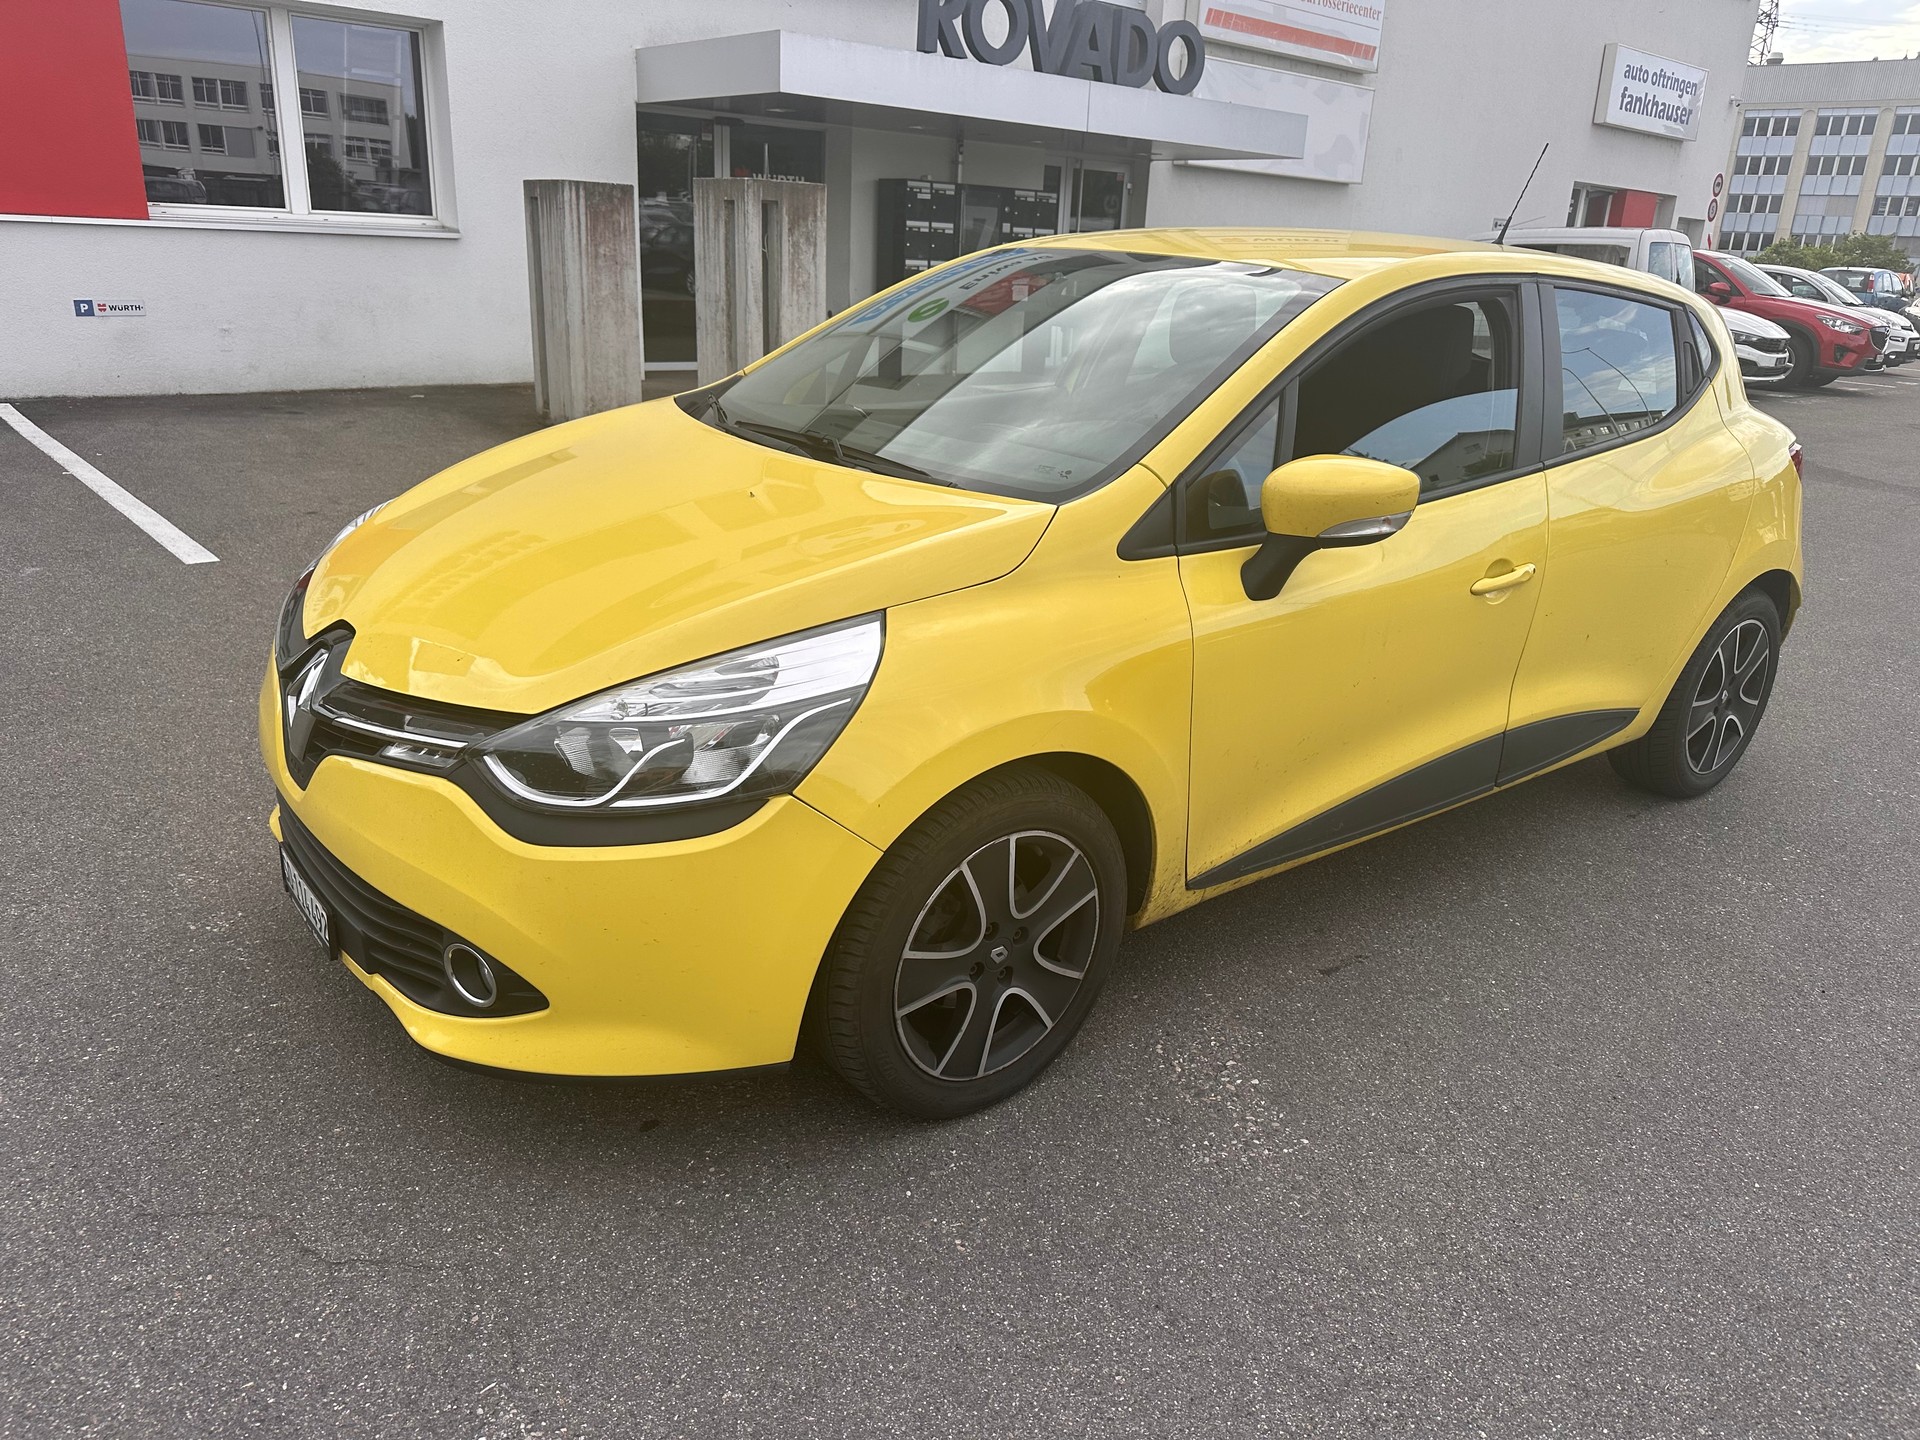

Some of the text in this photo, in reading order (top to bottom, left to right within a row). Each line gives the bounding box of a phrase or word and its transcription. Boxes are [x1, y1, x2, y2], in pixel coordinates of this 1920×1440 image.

[1302, 0, 1382, 20] osseriecenter
[916, 0, 1205, 95] ROVADO
[1624, 64, 1698, 99] auto oftringen
[1619, 86, 1693, 125] fankhauser
[80, 303, 141, 313] P WÜRTH
